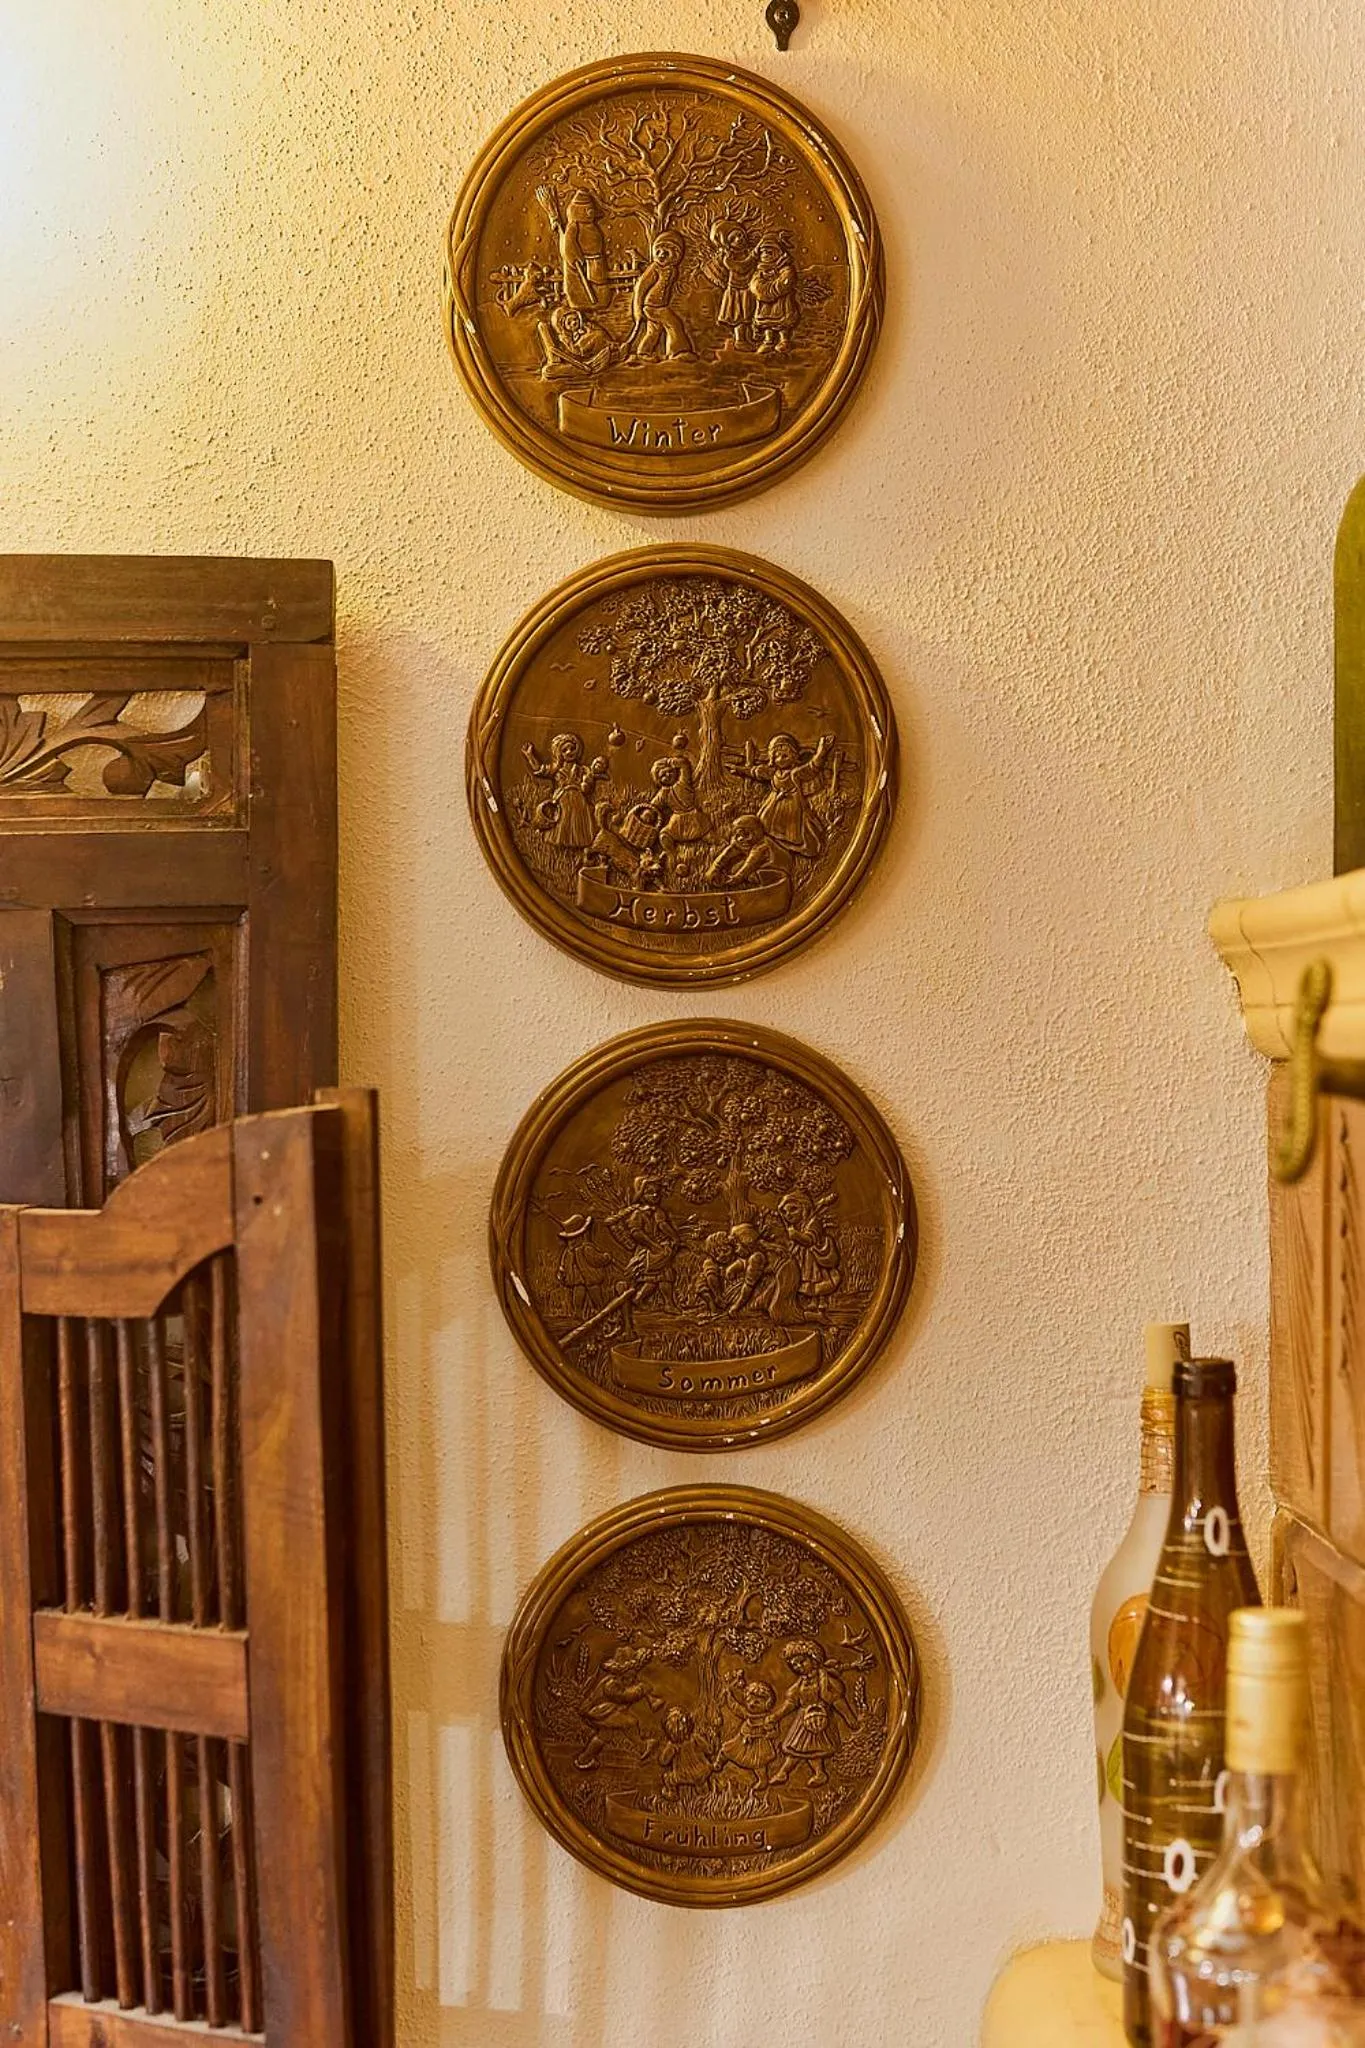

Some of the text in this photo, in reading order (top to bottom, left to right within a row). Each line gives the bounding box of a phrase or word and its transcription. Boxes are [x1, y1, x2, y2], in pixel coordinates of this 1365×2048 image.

[607, 417, 722, 447] Winter
[609, 893, 740, 928] Herbst
[657, 1365, 779, 1393] Sommer
